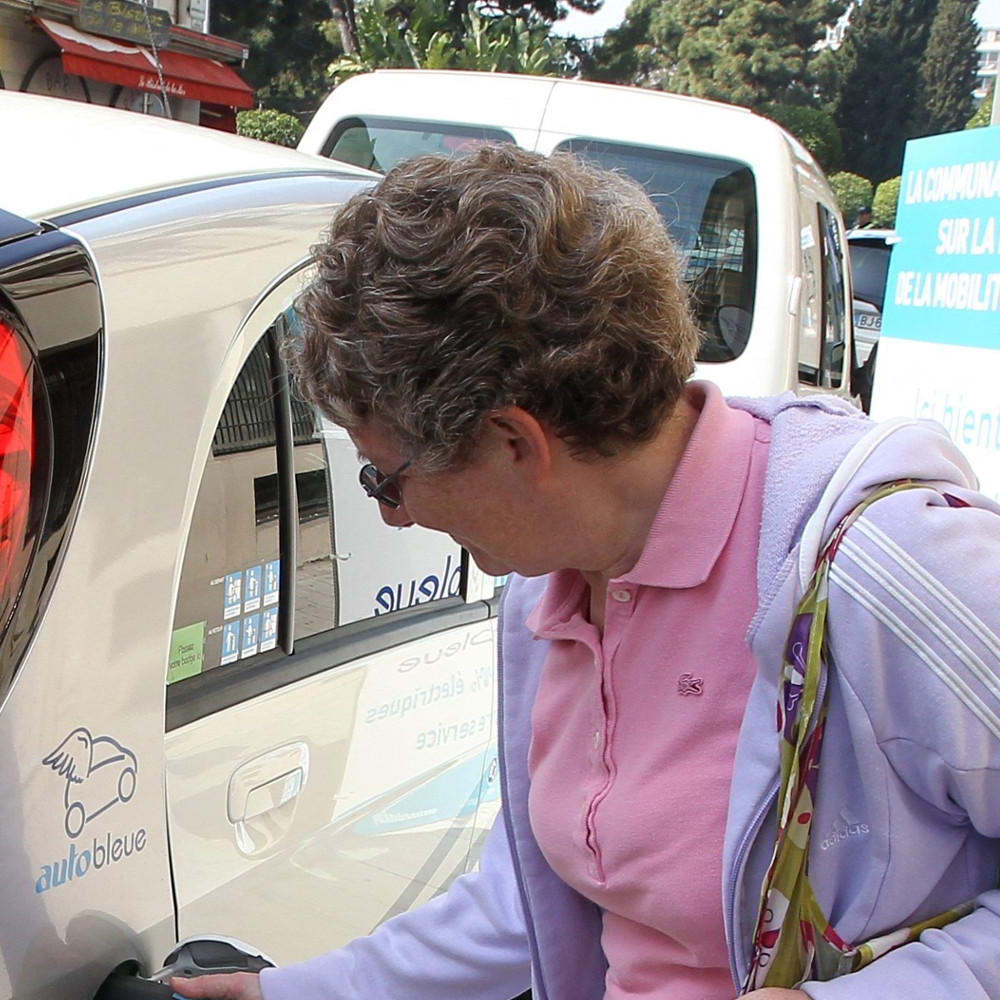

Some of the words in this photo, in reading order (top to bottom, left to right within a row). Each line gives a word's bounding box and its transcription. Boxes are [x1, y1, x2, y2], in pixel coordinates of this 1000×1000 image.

[905, 169, 923, 205] LA
[935, 217, 971, 256] SUR
[970, 217, 996, 256] LA
[894, 271, 916, 306] DE
[913, 271, 932, 308] LA
[34, 828, 147, 894] autobleue
